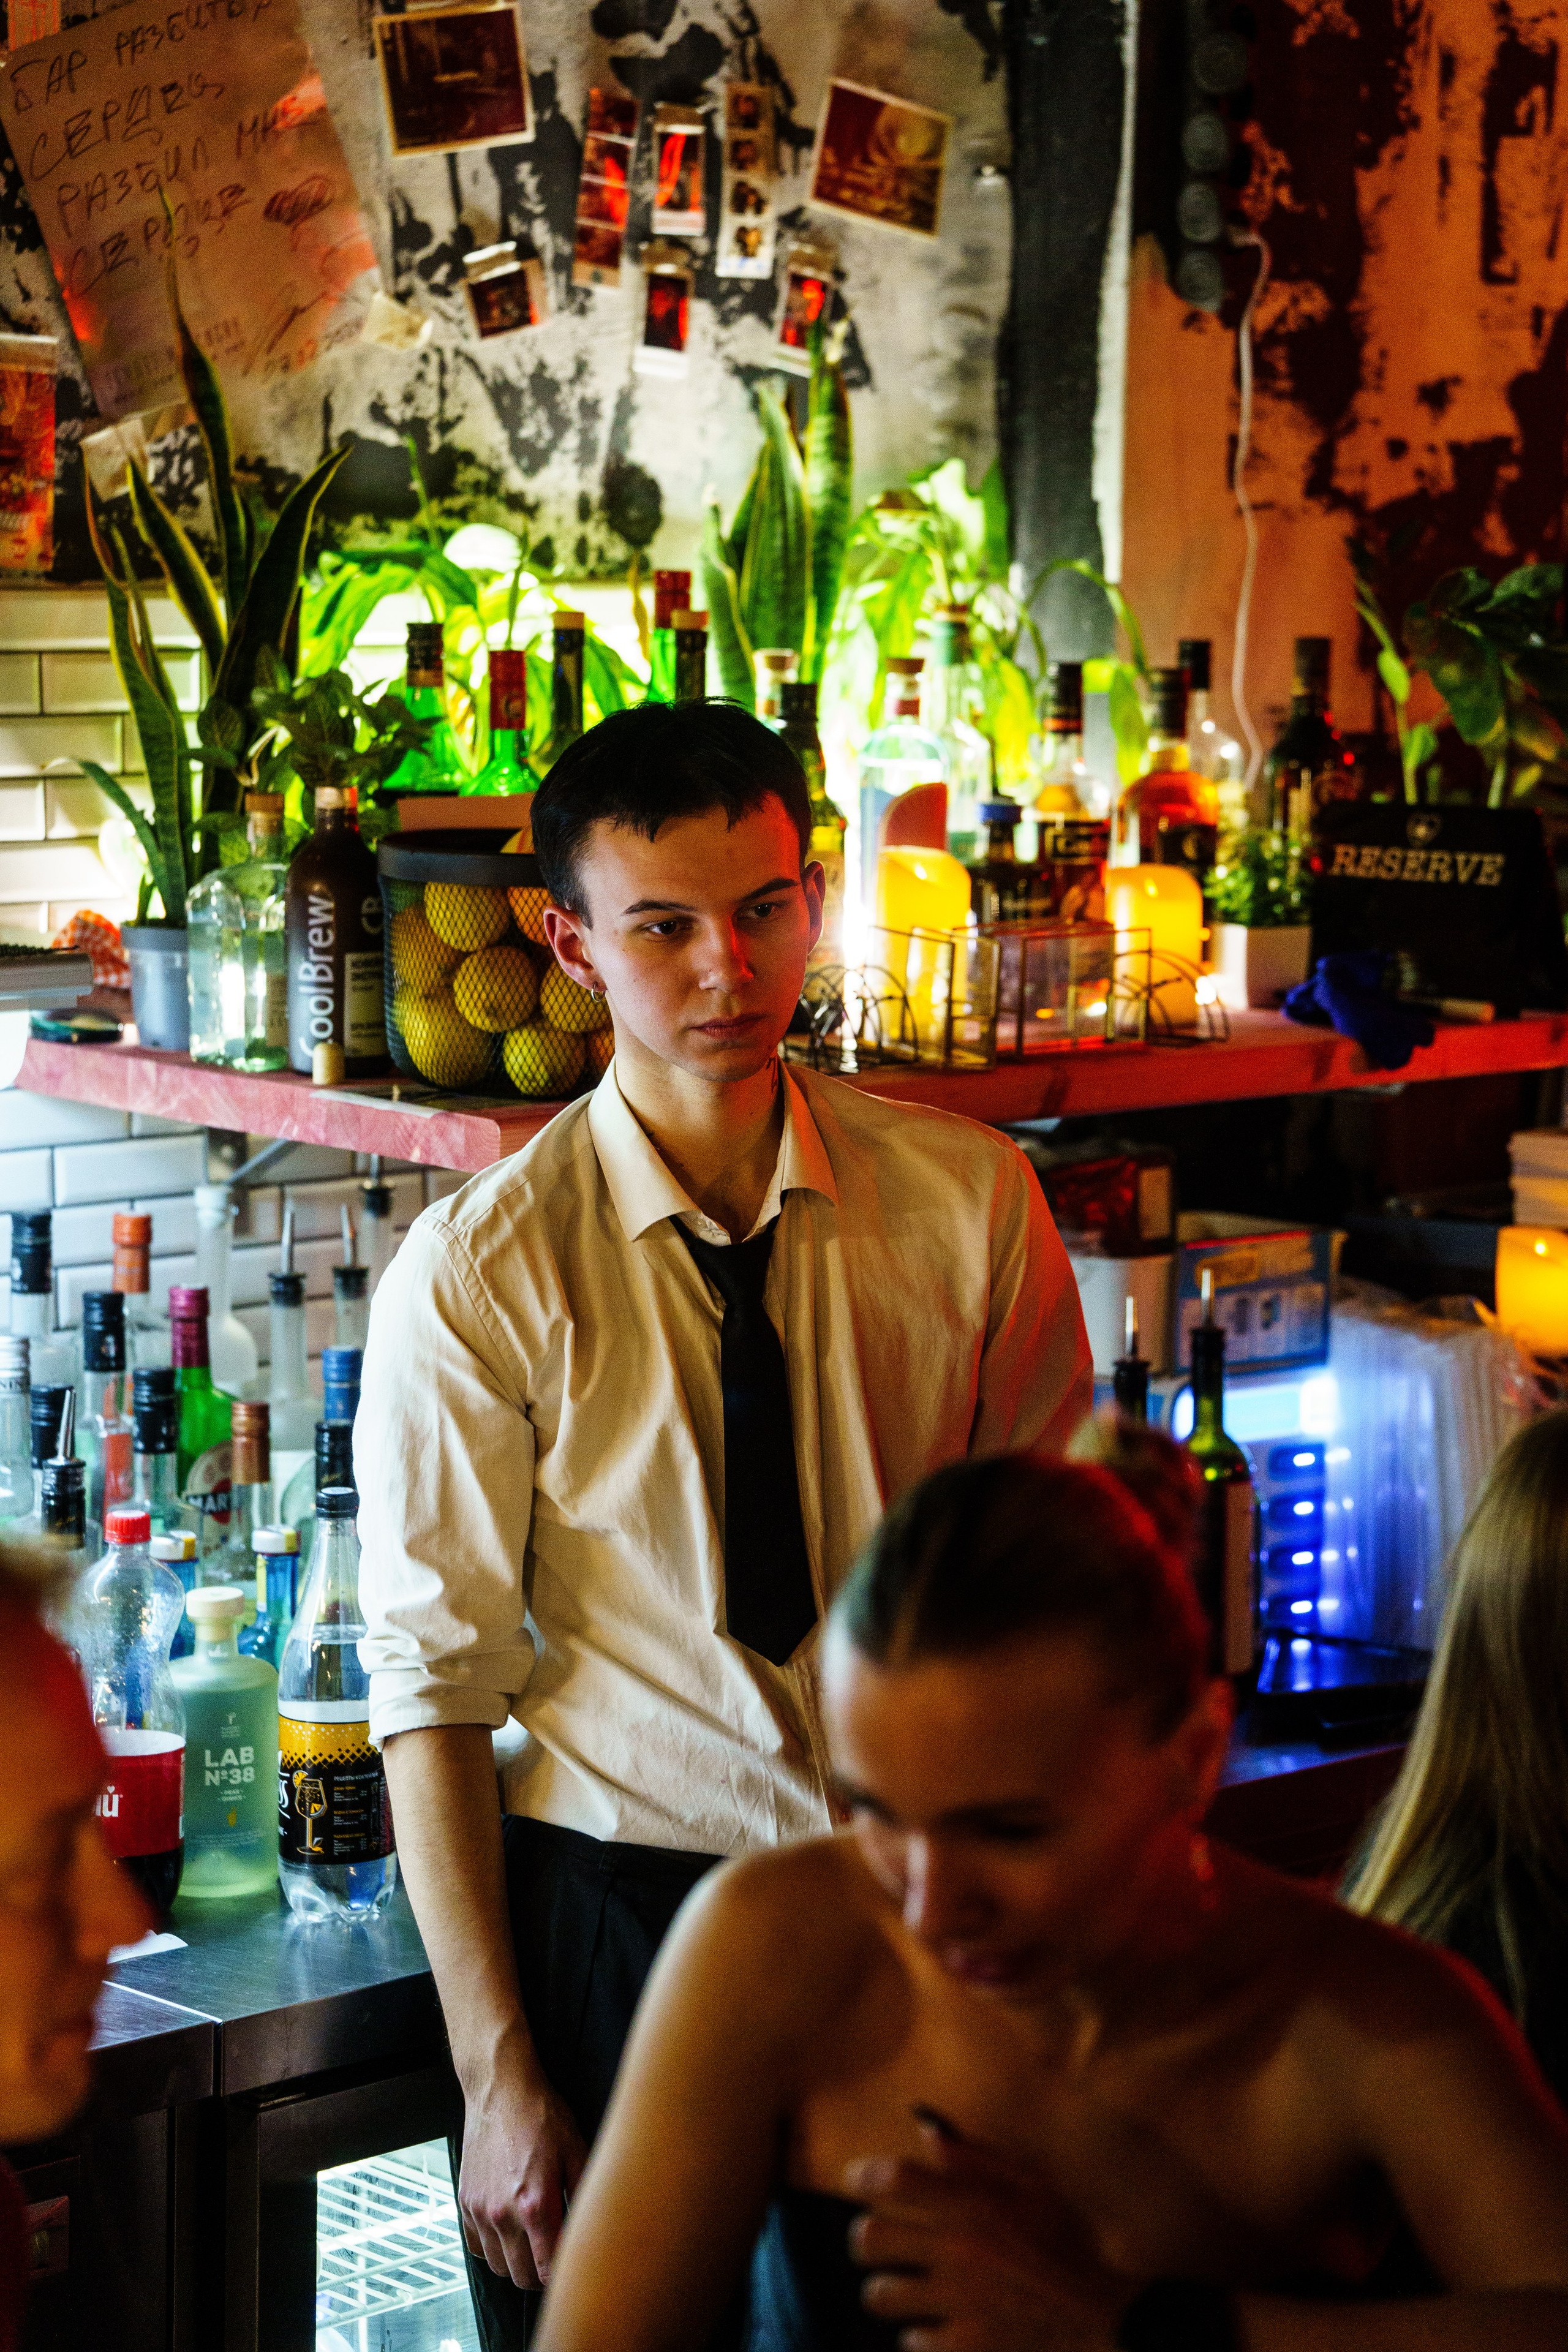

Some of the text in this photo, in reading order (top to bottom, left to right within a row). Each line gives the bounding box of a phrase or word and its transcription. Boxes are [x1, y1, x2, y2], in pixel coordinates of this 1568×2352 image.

[10, 50, 87, 114] БАР
[1328, 843, 1506, 886] RESERVE
[205, 1746, 255, 1768] LAB
